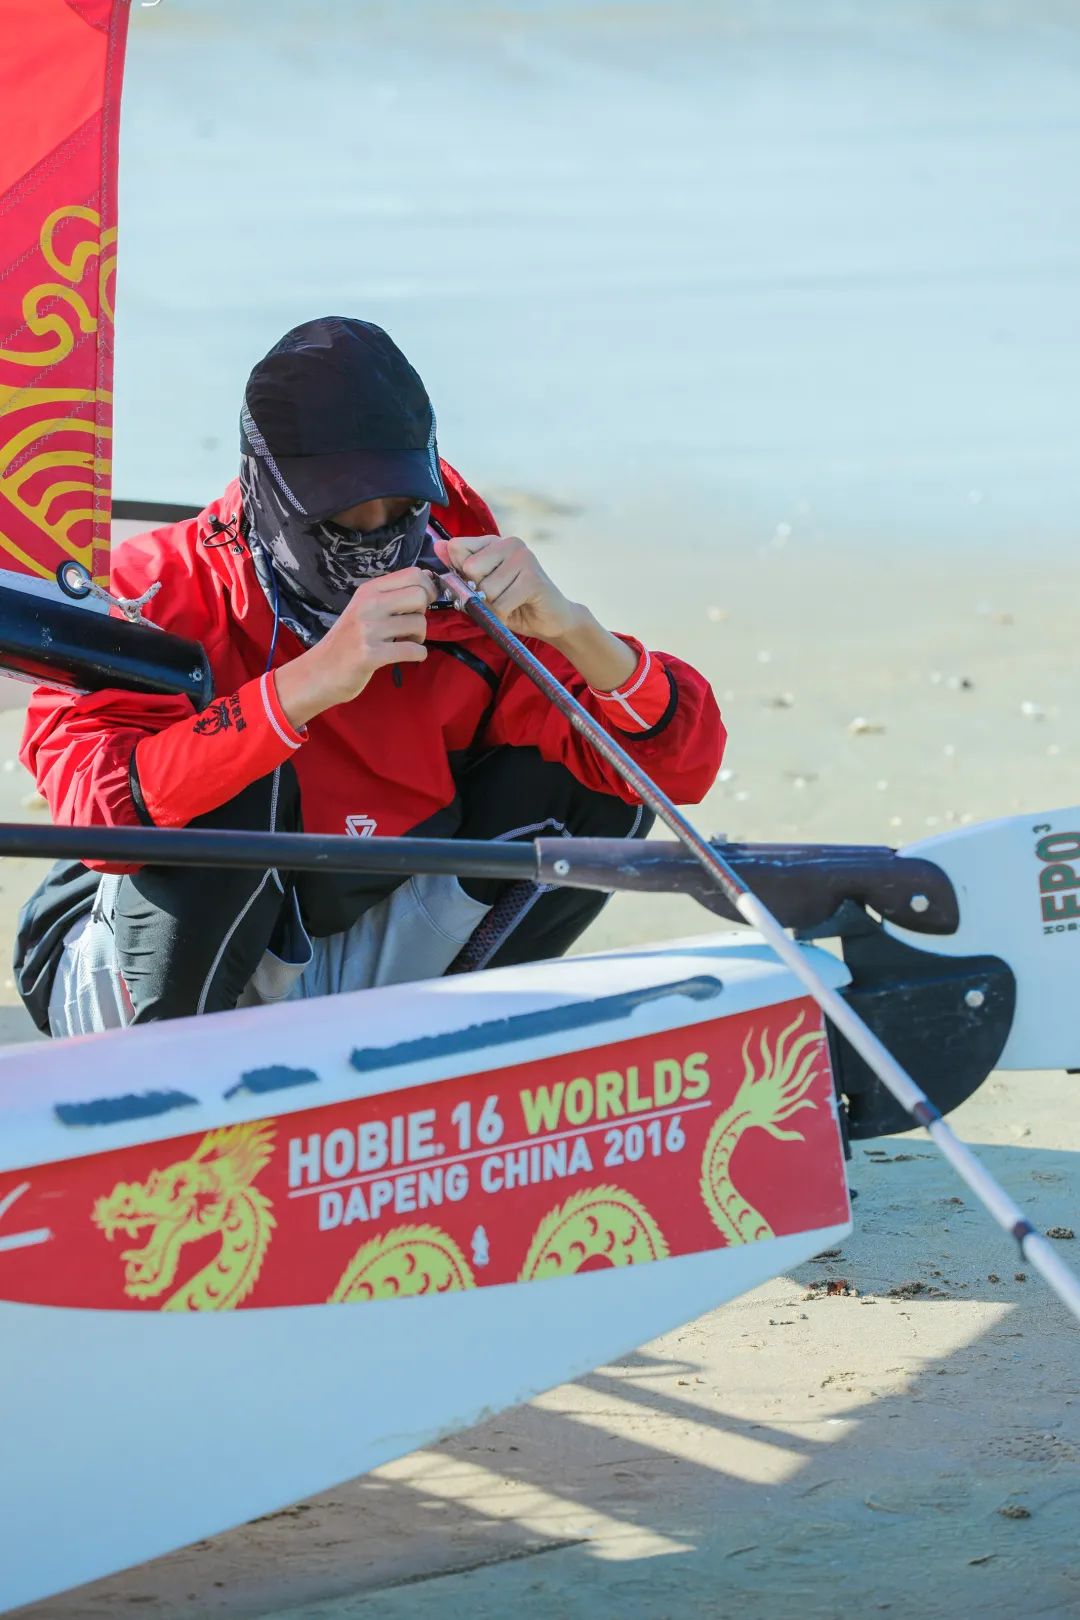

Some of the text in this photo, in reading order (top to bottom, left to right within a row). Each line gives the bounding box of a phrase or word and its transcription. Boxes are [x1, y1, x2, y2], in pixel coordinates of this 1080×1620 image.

[451, 1095, 504, 1150] 16
[520, 1052, 711, 1135] WORLDS
[318, 1116, 685, 1231] DAPENG CHINA 2016
